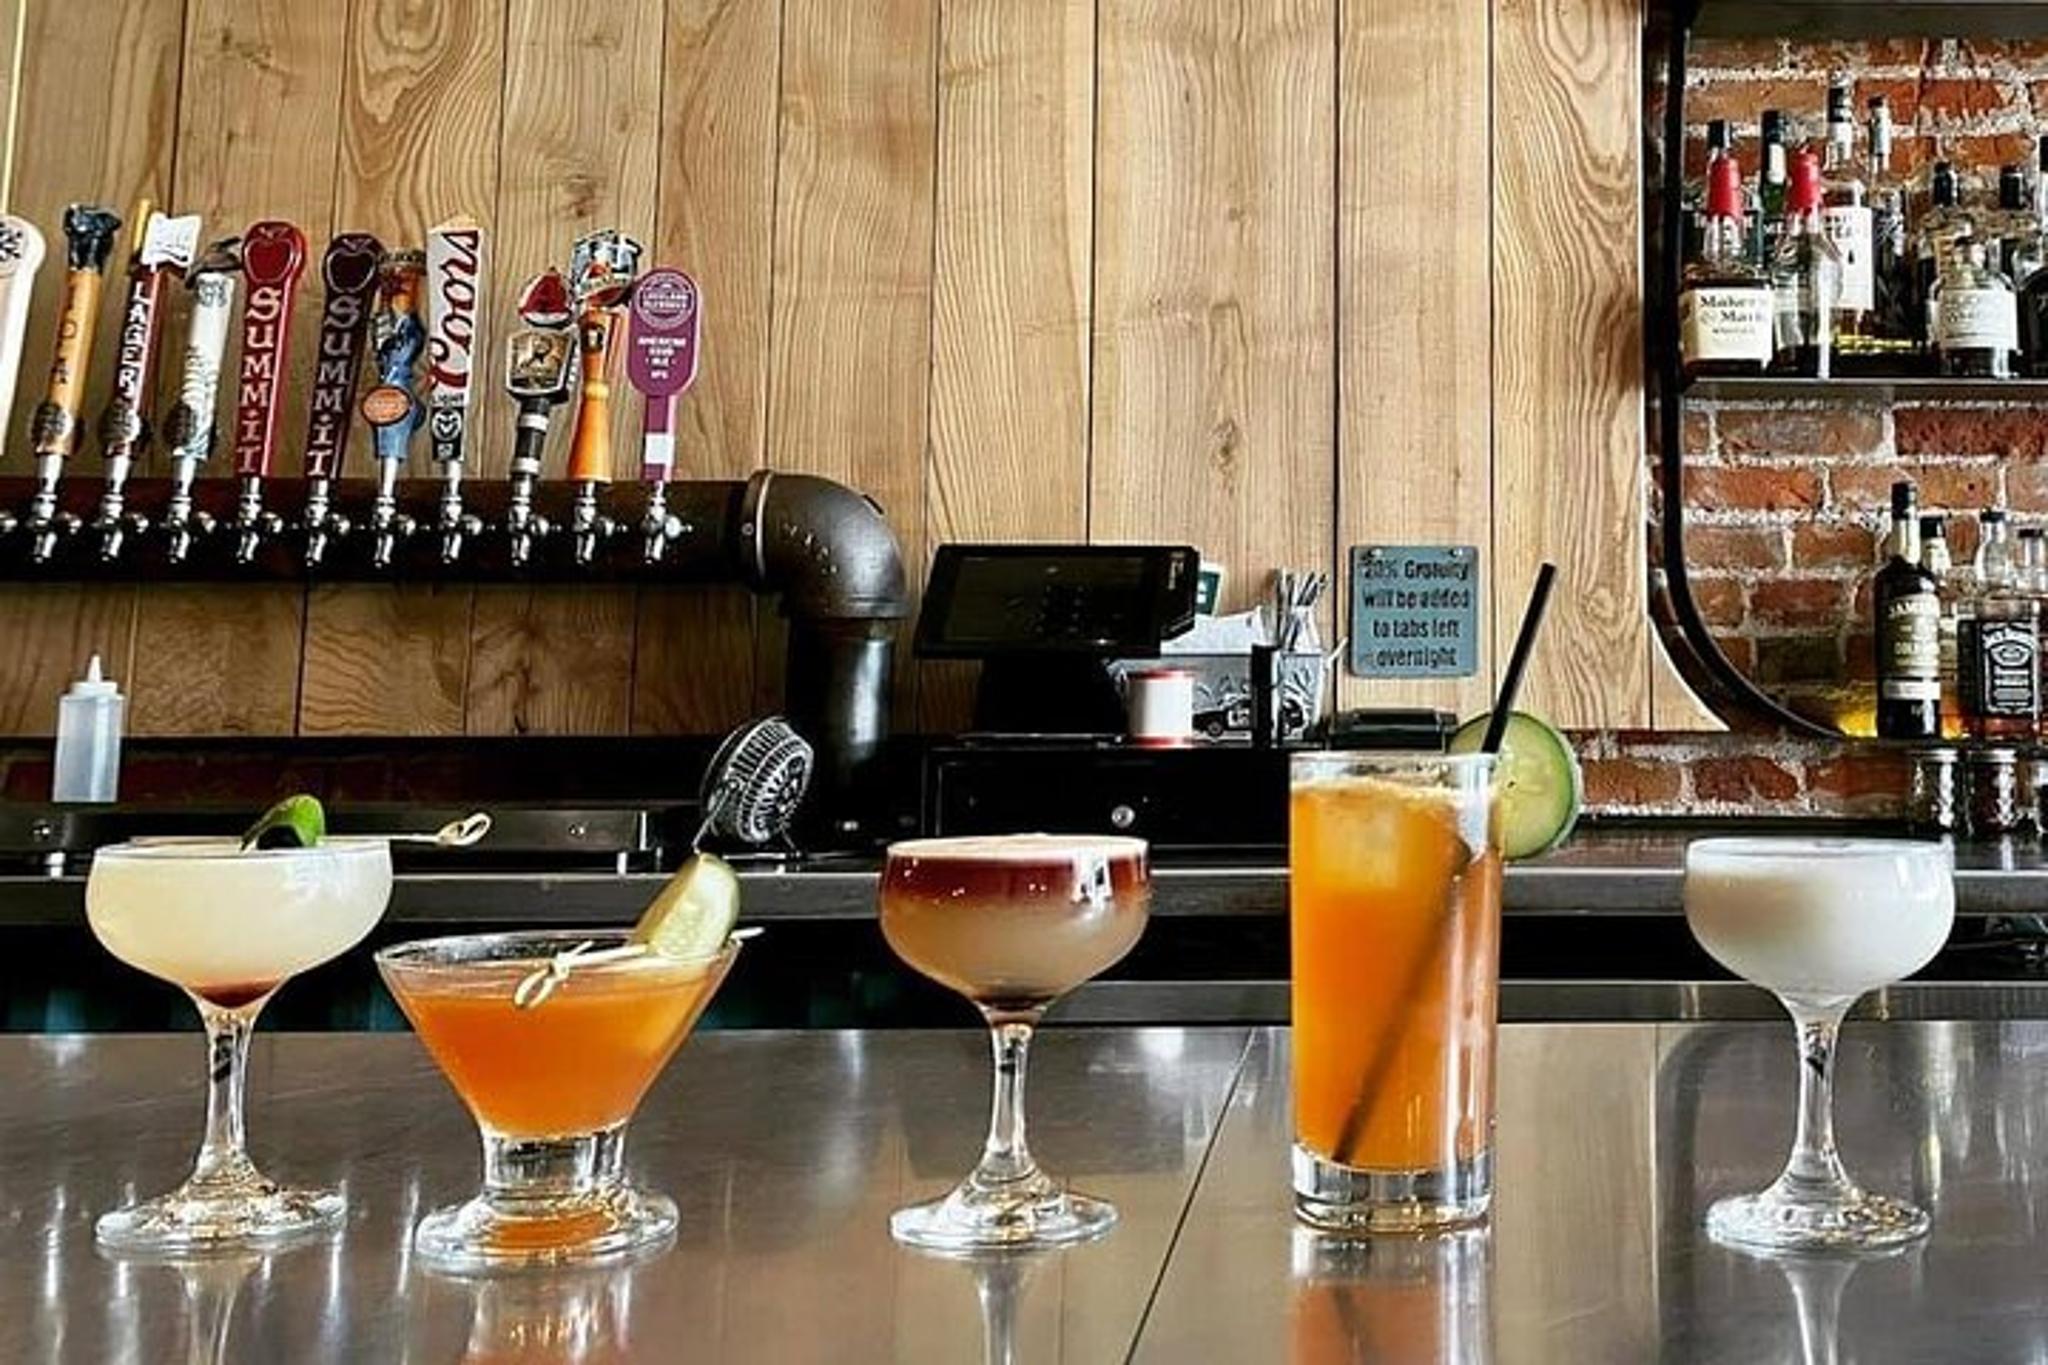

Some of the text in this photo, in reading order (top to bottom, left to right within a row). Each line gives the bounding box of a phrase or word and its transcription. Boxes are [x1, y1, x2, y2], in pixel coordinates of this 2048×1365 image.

[120, 281, 148, 394] LAGER
[1362, 588, 1469, 609] will be added
[1373, 619, 1460, 638] to tabs left
[1376, 647, 1458, 669] overnight
